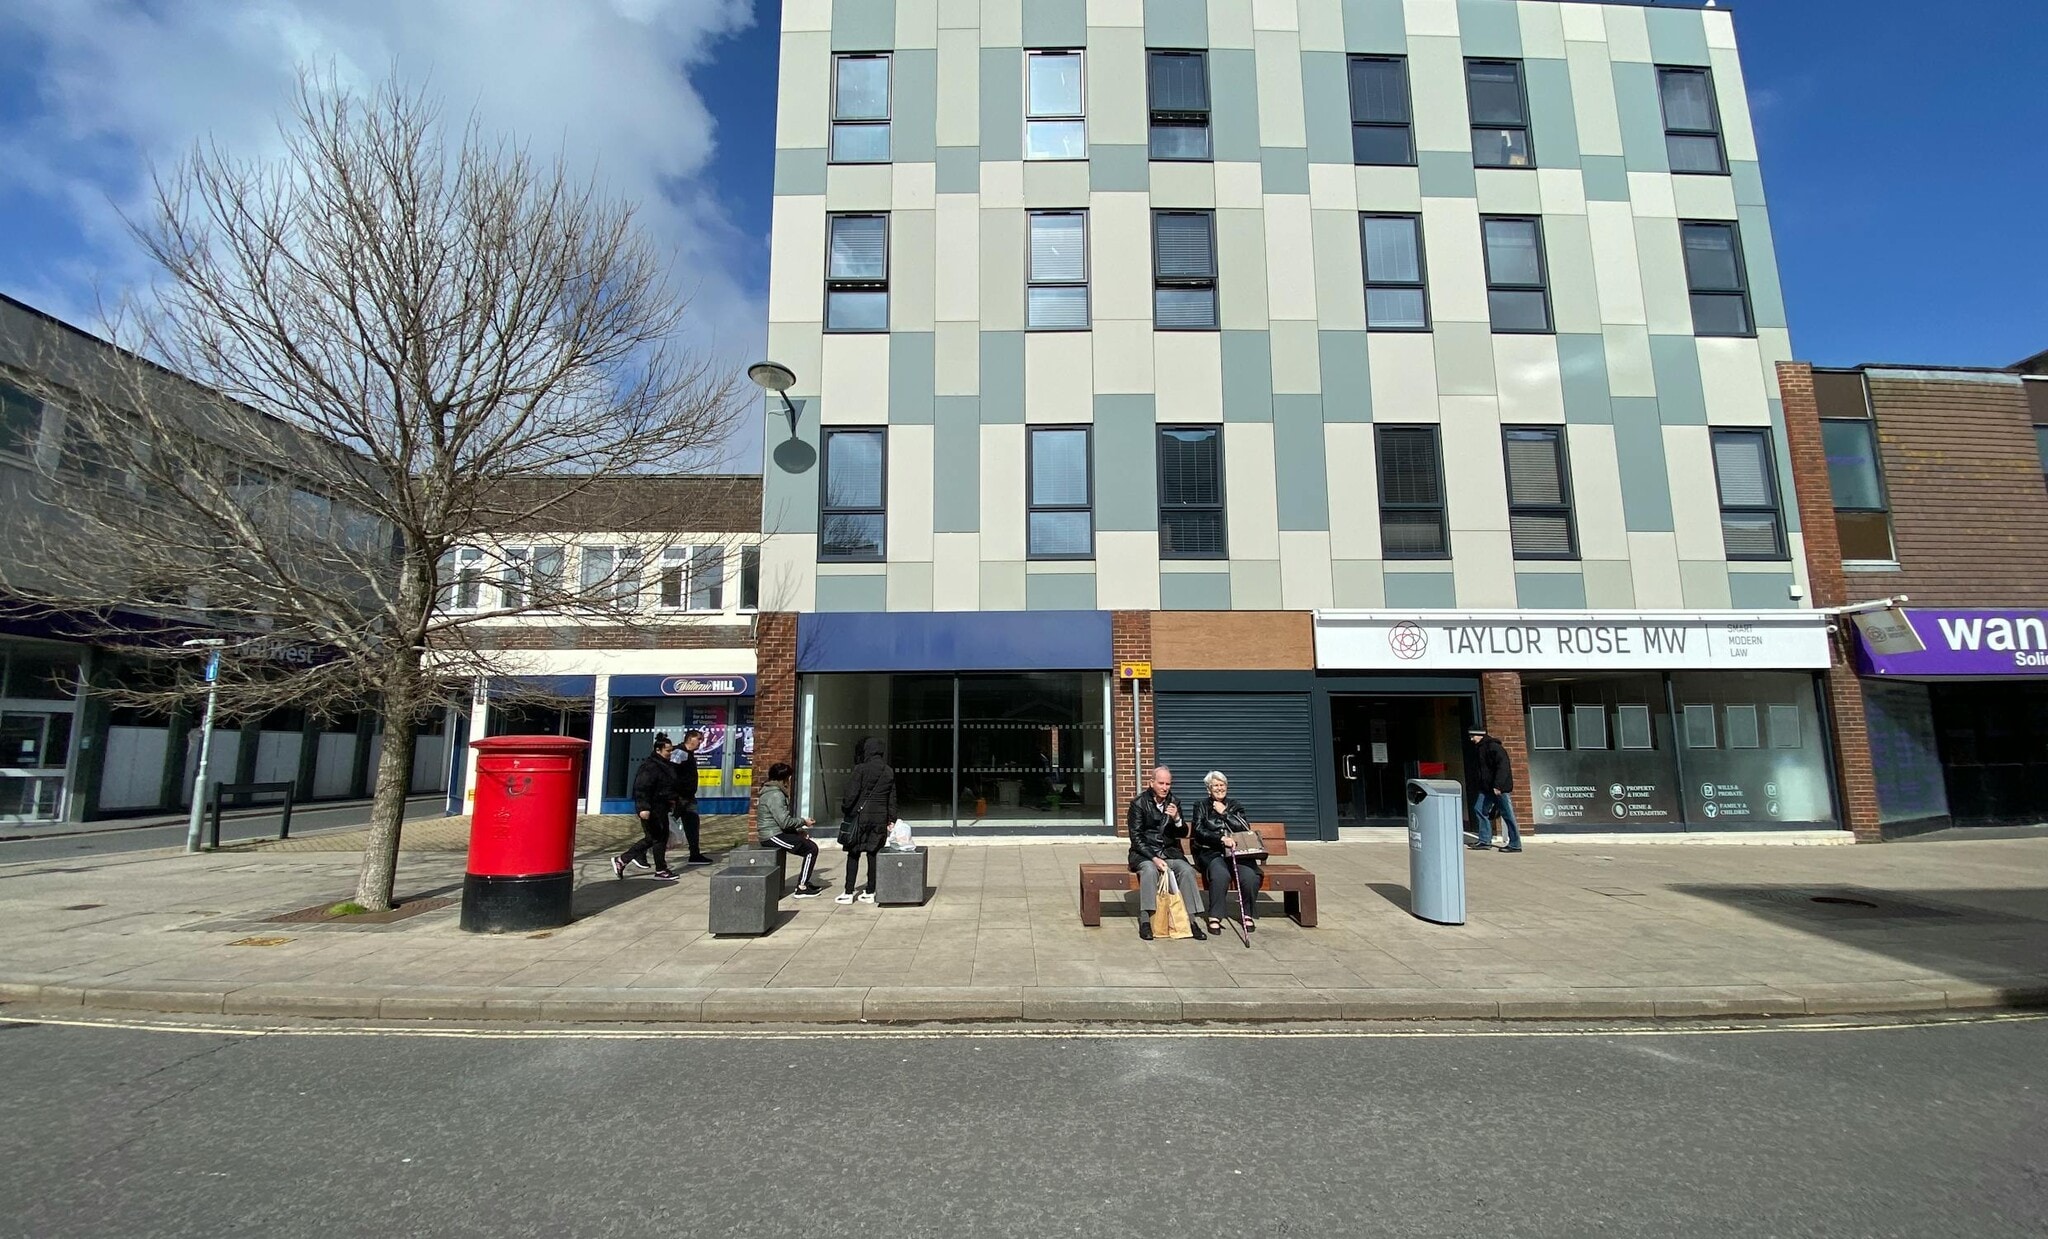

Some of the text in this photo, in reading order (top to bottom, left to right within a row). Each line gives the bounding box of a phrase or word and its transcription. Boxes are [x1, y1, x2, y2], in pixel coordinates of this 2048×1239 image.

[1727, 624, 1753, 633] SMART
[1443, 627, 1687, 653] TAYLOR ROSE MW
[1728, 636, 1763, 645] MODERN
[1730, 648, 1748, 657] LAW
[712, 680, 734, 690] HILL
